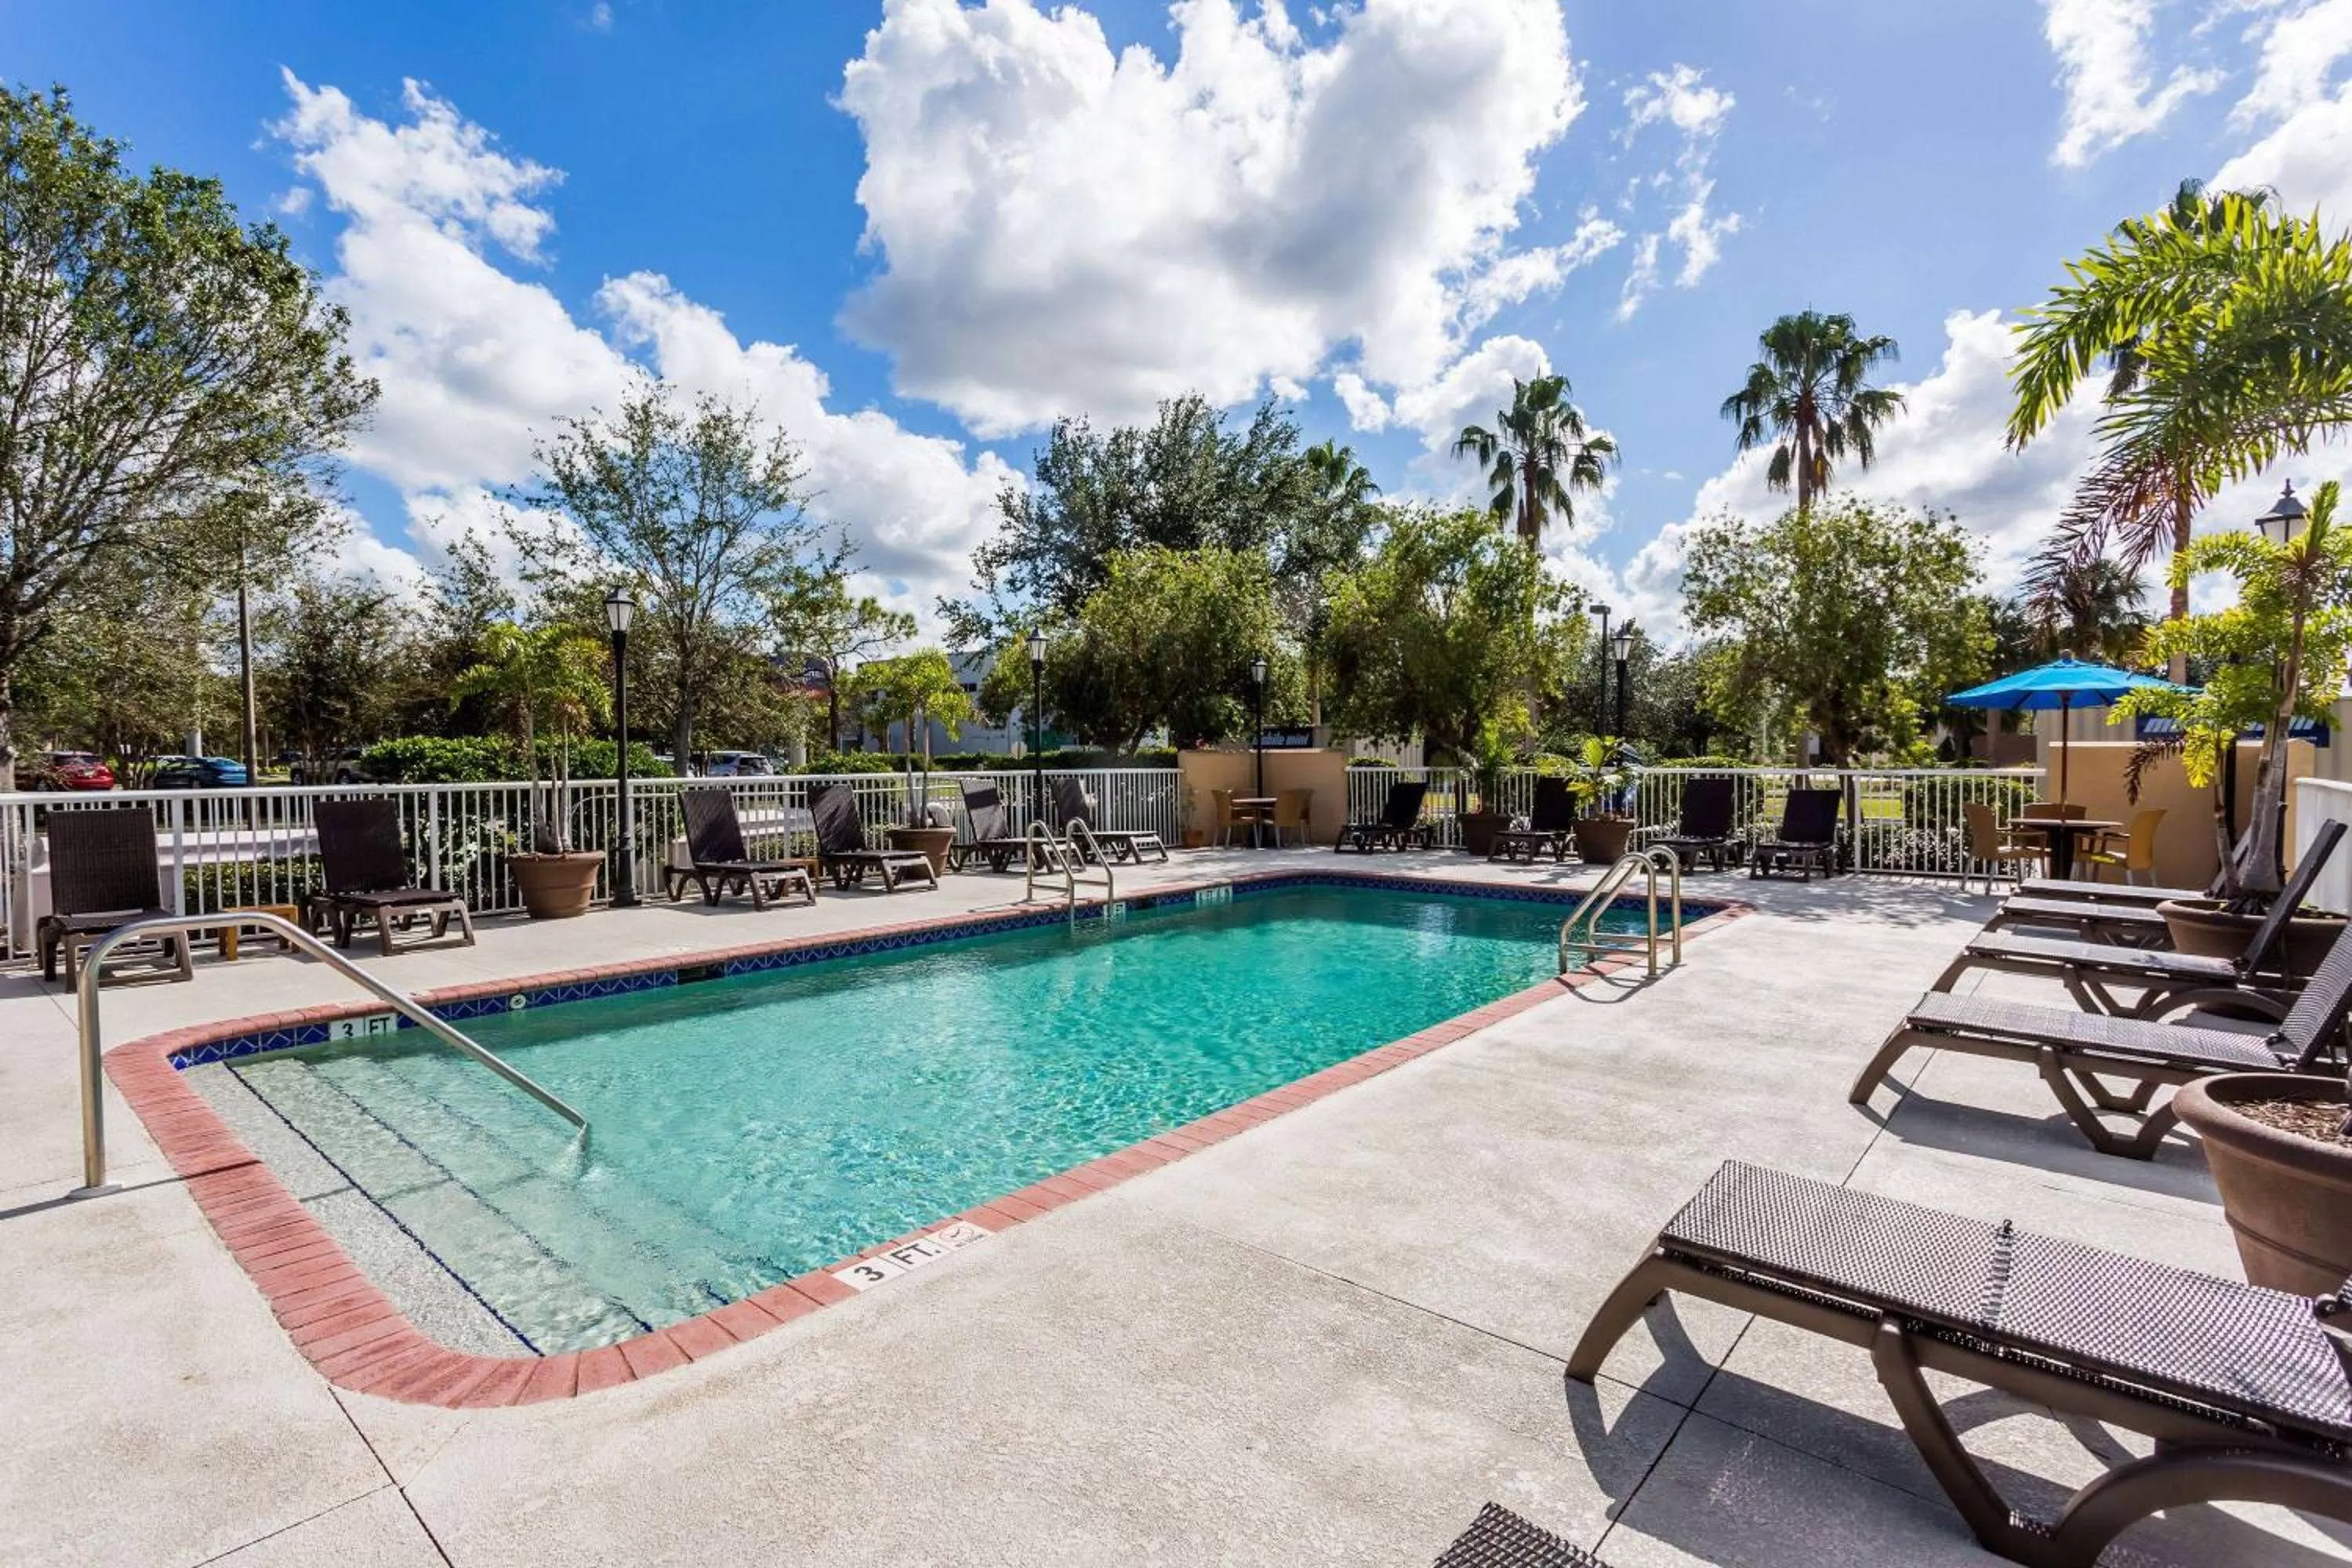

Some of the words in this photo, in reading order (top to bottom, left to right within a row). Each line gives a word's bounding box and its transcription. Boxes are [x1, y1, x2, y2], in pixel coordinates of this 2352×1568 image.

[342, 1022, 354, 1038] 3
[369, 1016, 390, 1035] FT
[854, 1265, 885, 1282] 3
